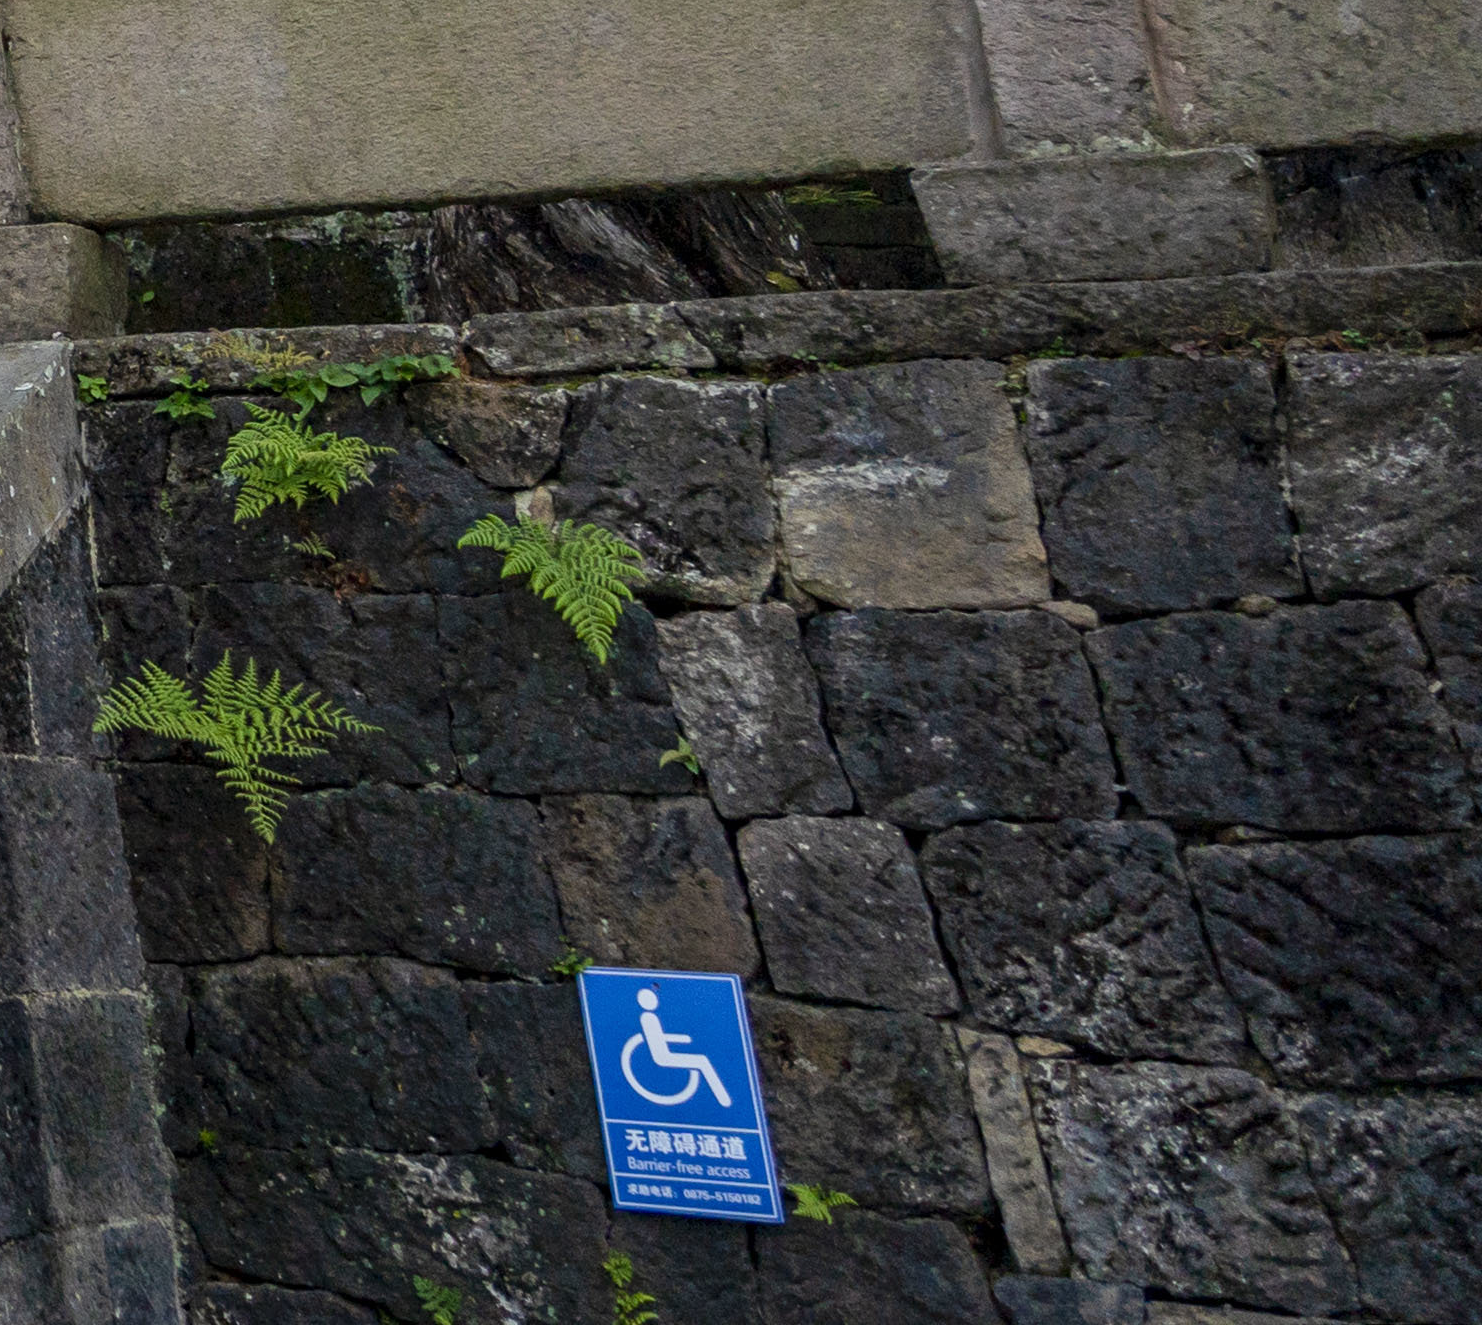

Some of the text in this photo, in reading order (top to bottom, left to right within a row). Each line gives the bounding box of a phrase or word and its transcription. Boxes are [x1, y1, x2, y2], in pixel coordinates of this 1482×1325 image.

[625, 1129, 747, 1161] 无障碍通道
[627, 1156, 751, 1179] Barrier-free access
